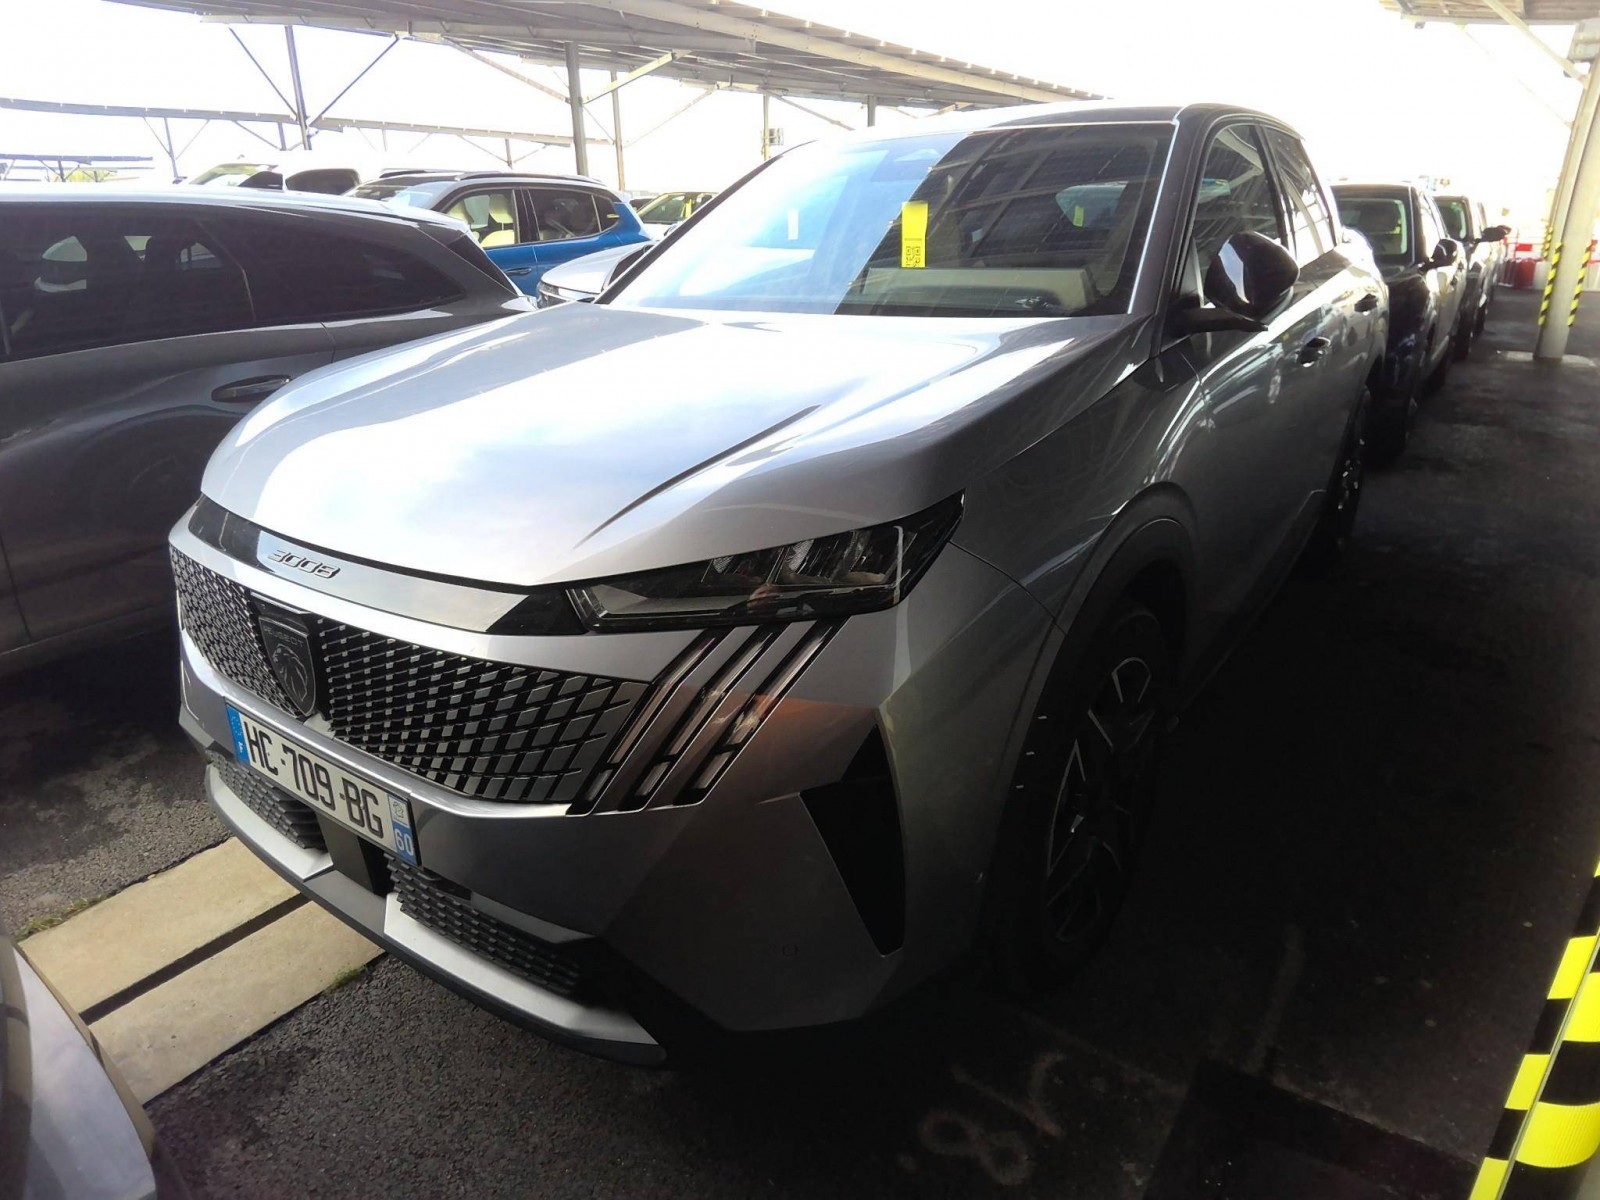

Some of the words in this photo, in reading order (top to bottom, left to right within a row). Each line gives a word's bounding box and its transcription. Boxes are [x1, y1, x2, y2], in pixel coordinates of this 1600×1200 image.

[267, 549, 341, 579] 3008
[242, 719, 385, 840] HC-709-BG
[394, 828, 415, 857] 60
